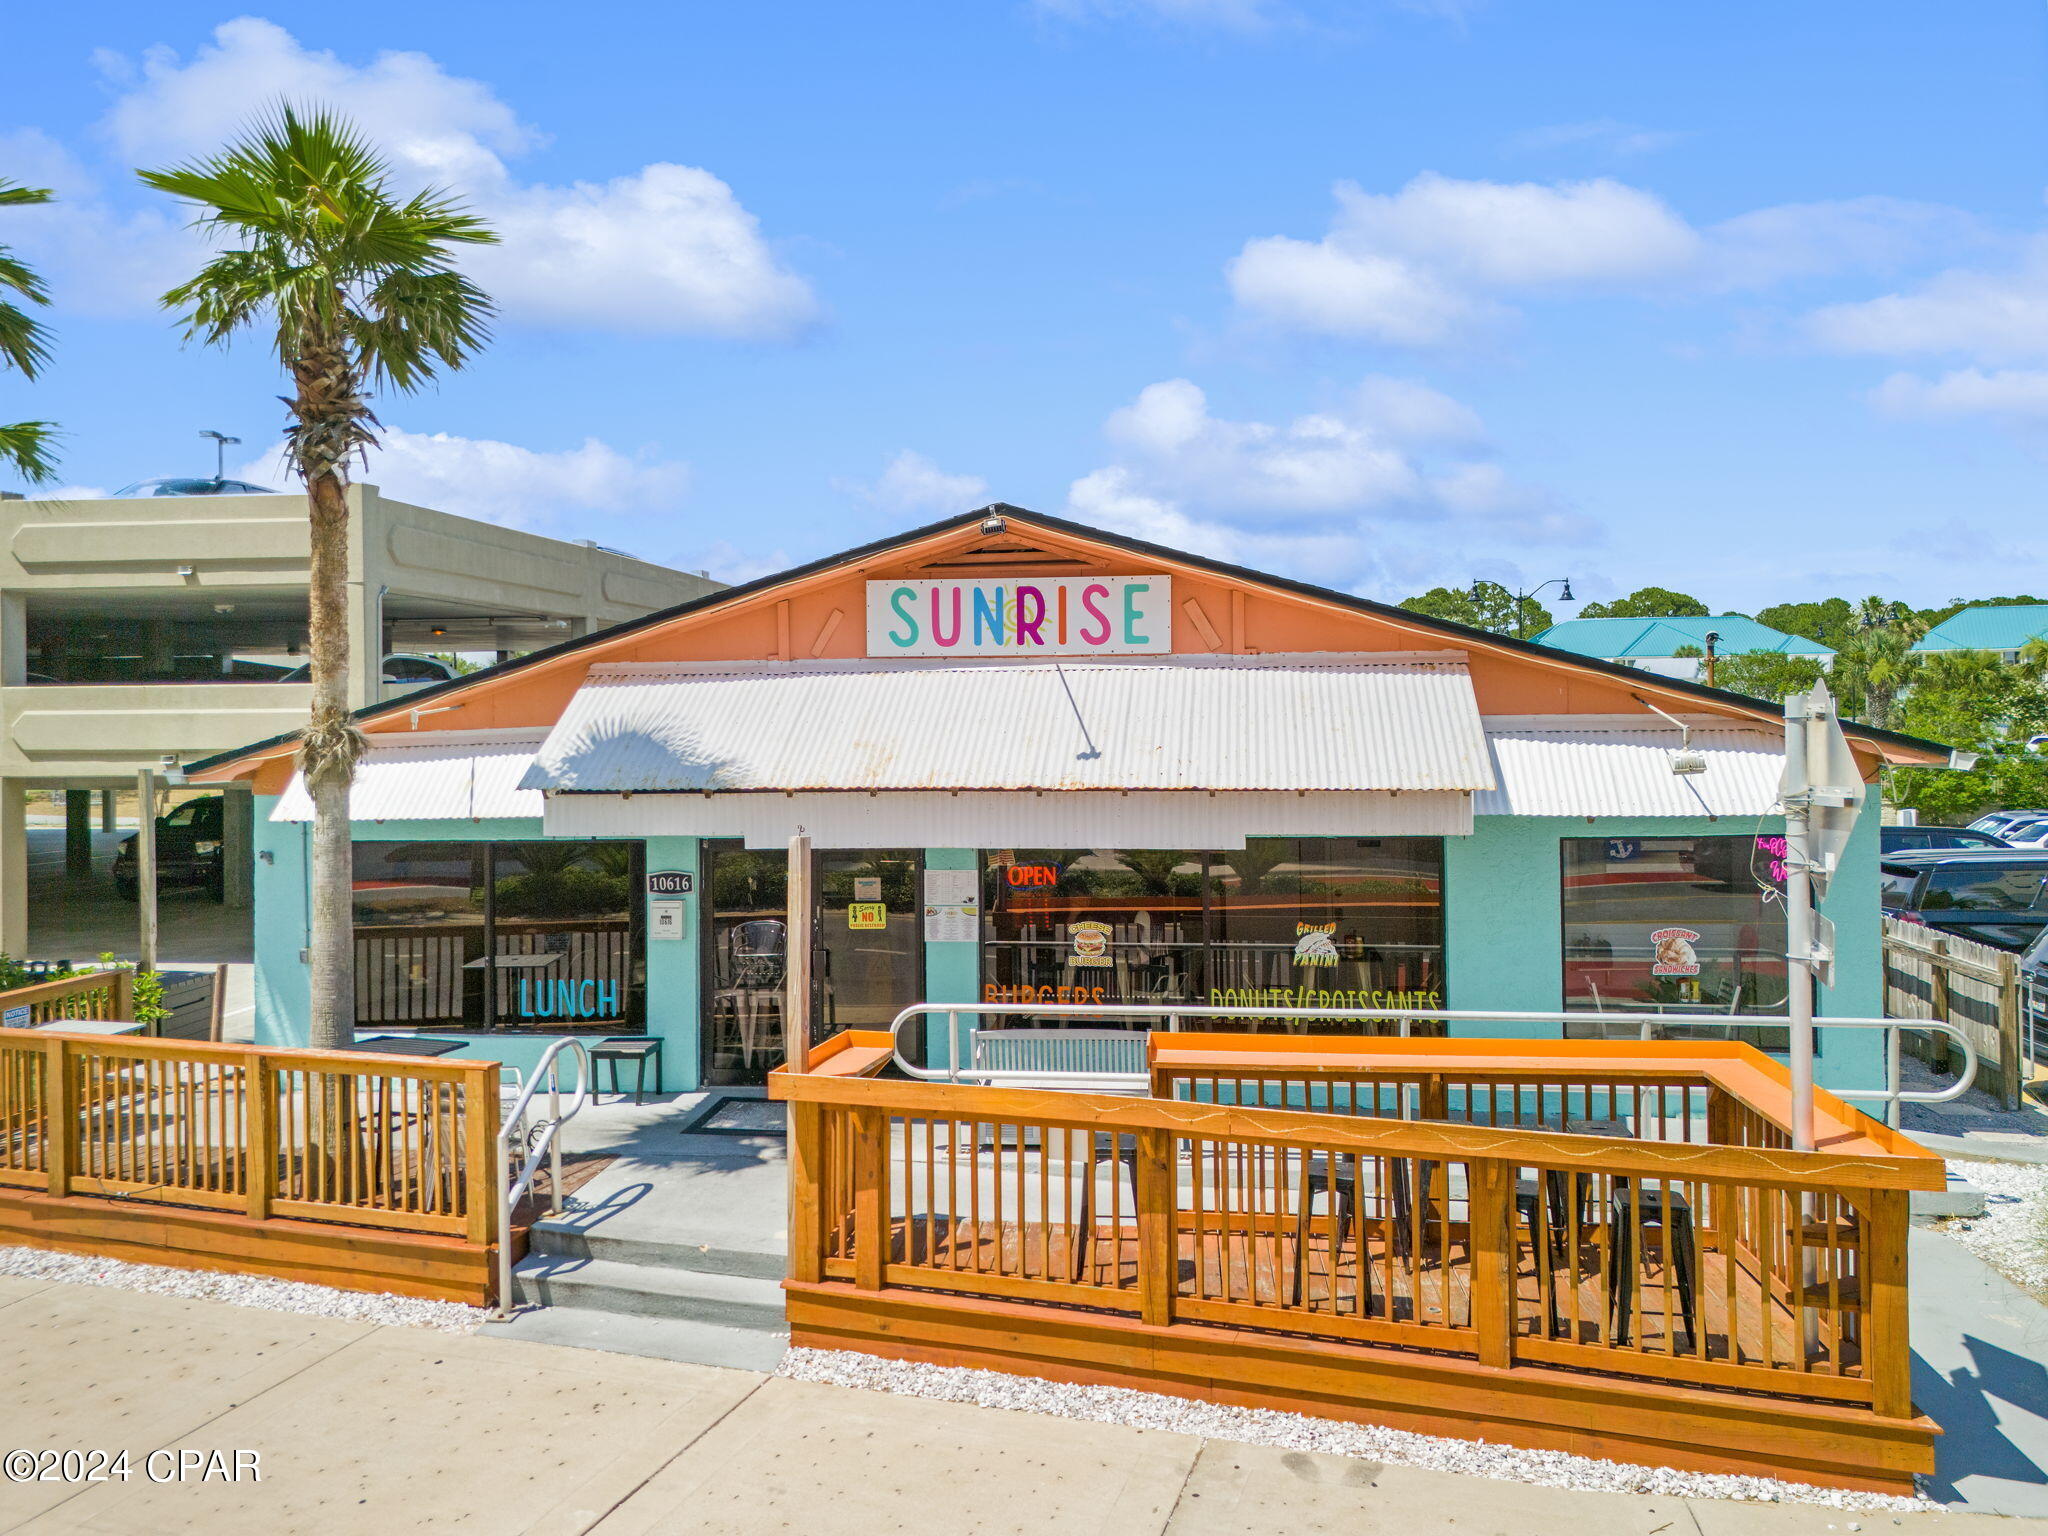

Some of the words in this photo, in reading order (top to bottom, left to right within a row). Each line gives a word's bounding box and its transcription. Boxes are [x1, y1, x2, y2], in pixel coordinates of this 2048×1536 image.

[888, 584, 1149, 647] SUNRISE
[1008, 865, 1057, 886] OPEN
[651, 877, 689, 891] 10616
[861, 911, 875, 923] NO
[1068, 922, 1113, 935] CHEESE
[1296, 921, 1337, 937] GRILLED
[1651, 930, 1698, 943] CROISSANT
[1069, 956, 1113, 967] BURGER
[1293, 953, 1339, 967] PANINI
[1653, 965, 1698, 975] SANDWICHES
[520, 978, 617, 1018] LUNCH
[985, 983, 1105, 1018] BURGERS
[1210, 985, 1439, 1026] DONUTS/CROISSANTS
